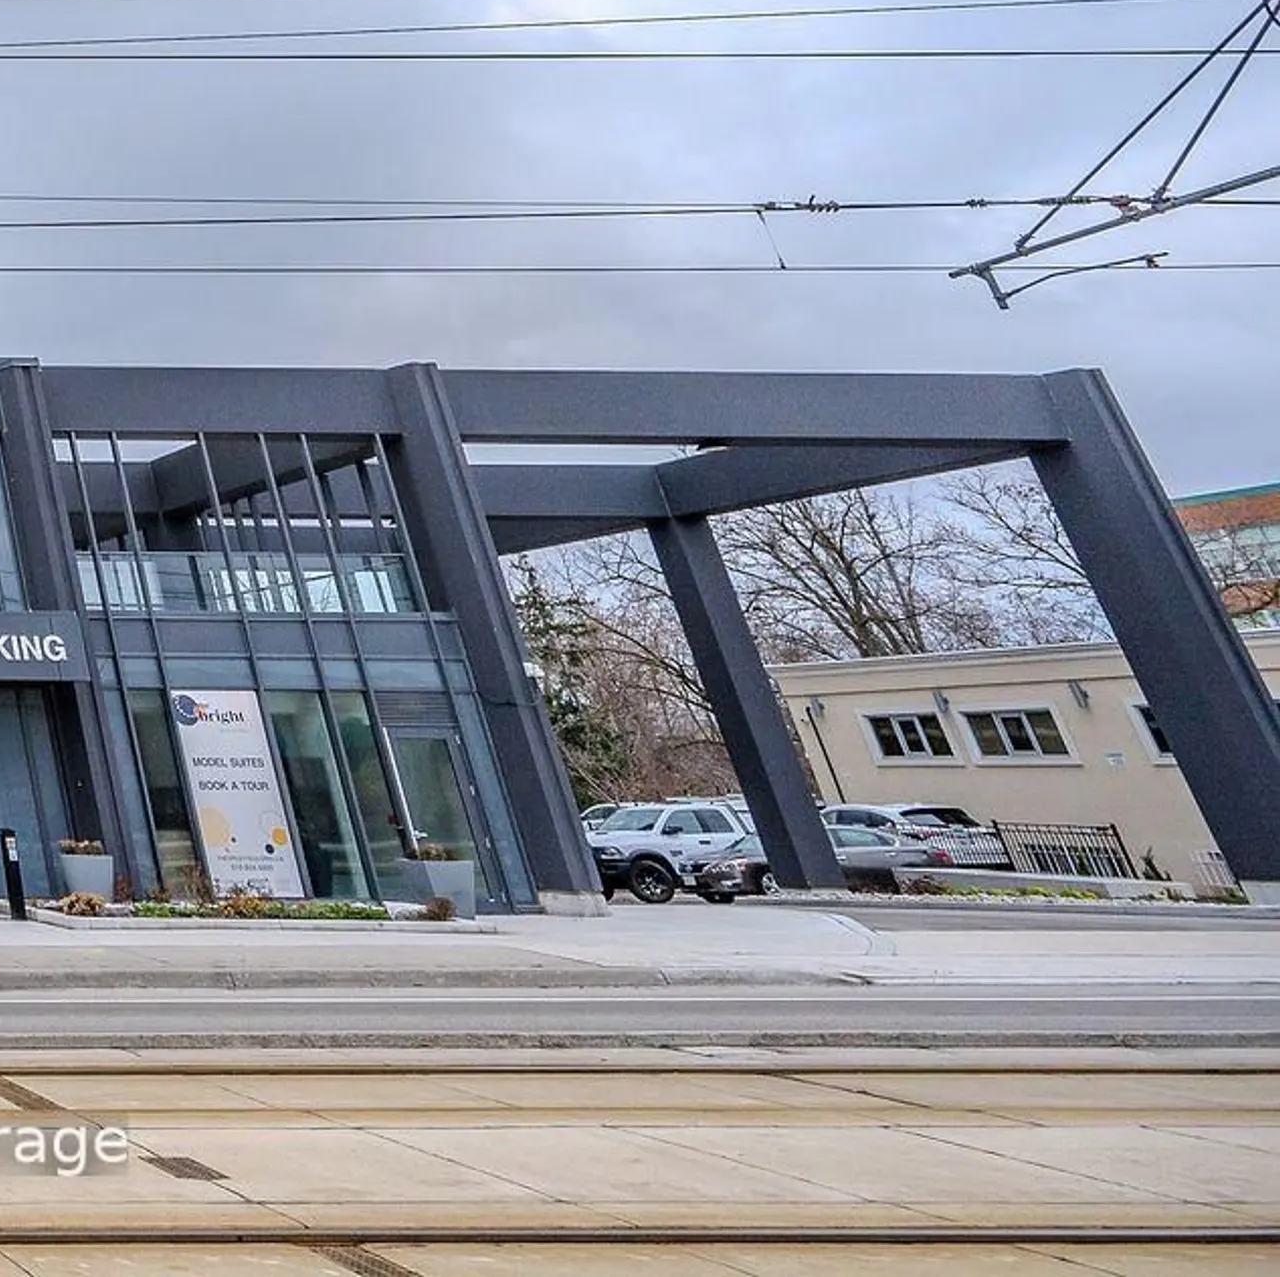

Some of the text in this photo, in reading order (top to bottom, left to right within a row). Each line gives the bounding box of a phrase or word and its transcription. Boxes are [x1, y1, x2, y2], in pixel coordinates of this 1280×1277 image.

[198, 708, 245, 724] bright
[192, 756, 265, 768] MODEL SUITES
[198, 780, 271, 792] BOOK A TOUR
